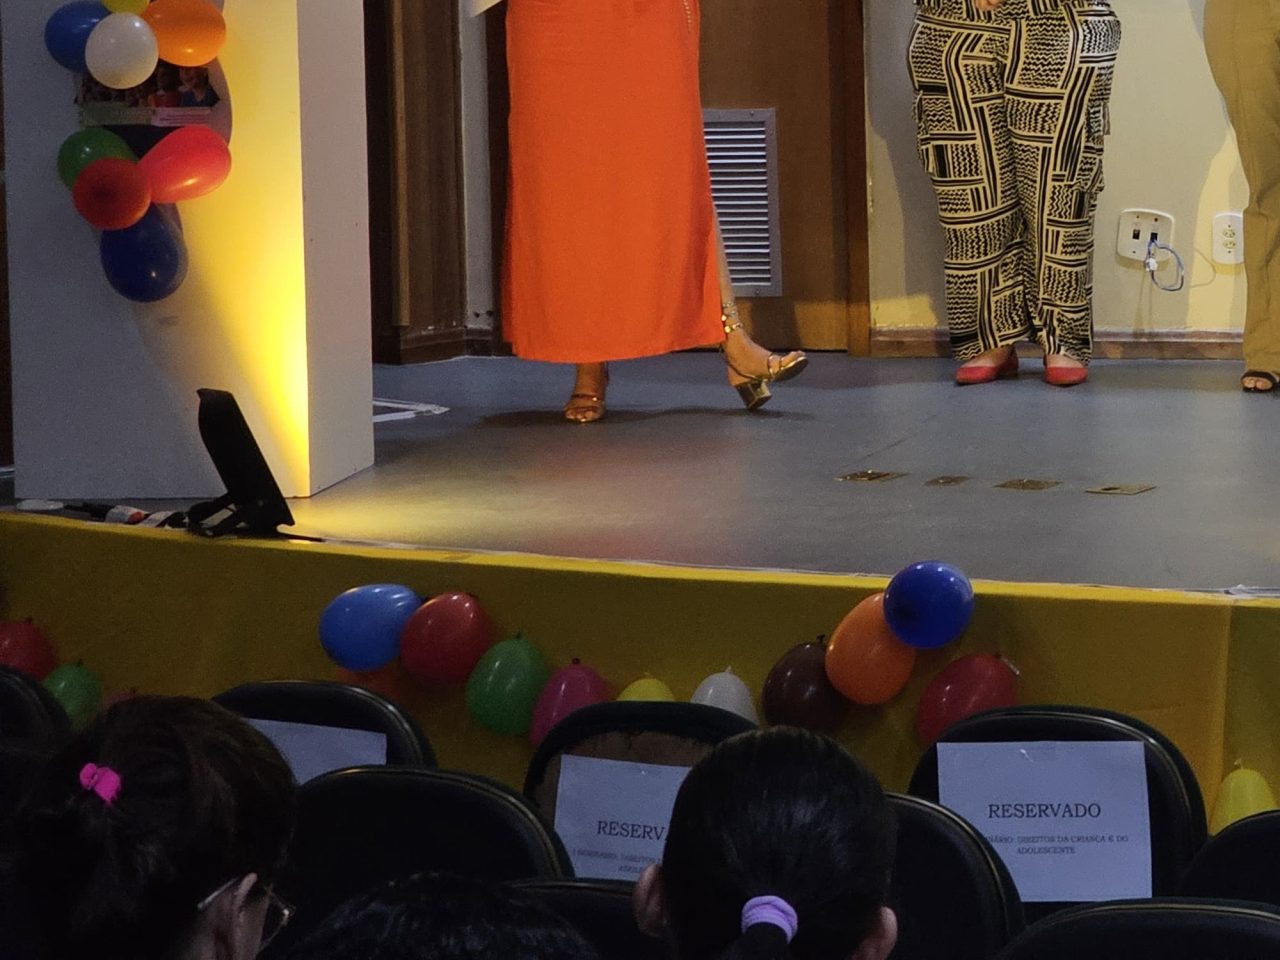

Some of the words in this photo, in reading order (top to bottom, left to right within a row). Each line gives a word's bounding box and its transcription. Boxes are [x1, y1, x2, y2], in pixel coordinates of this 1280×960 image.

[988, 802, 1102, 819] RESERVADO
[597, 820, 667, 841] RESERV
[1017, 846, 1076, 855] ADOLESCENTE
